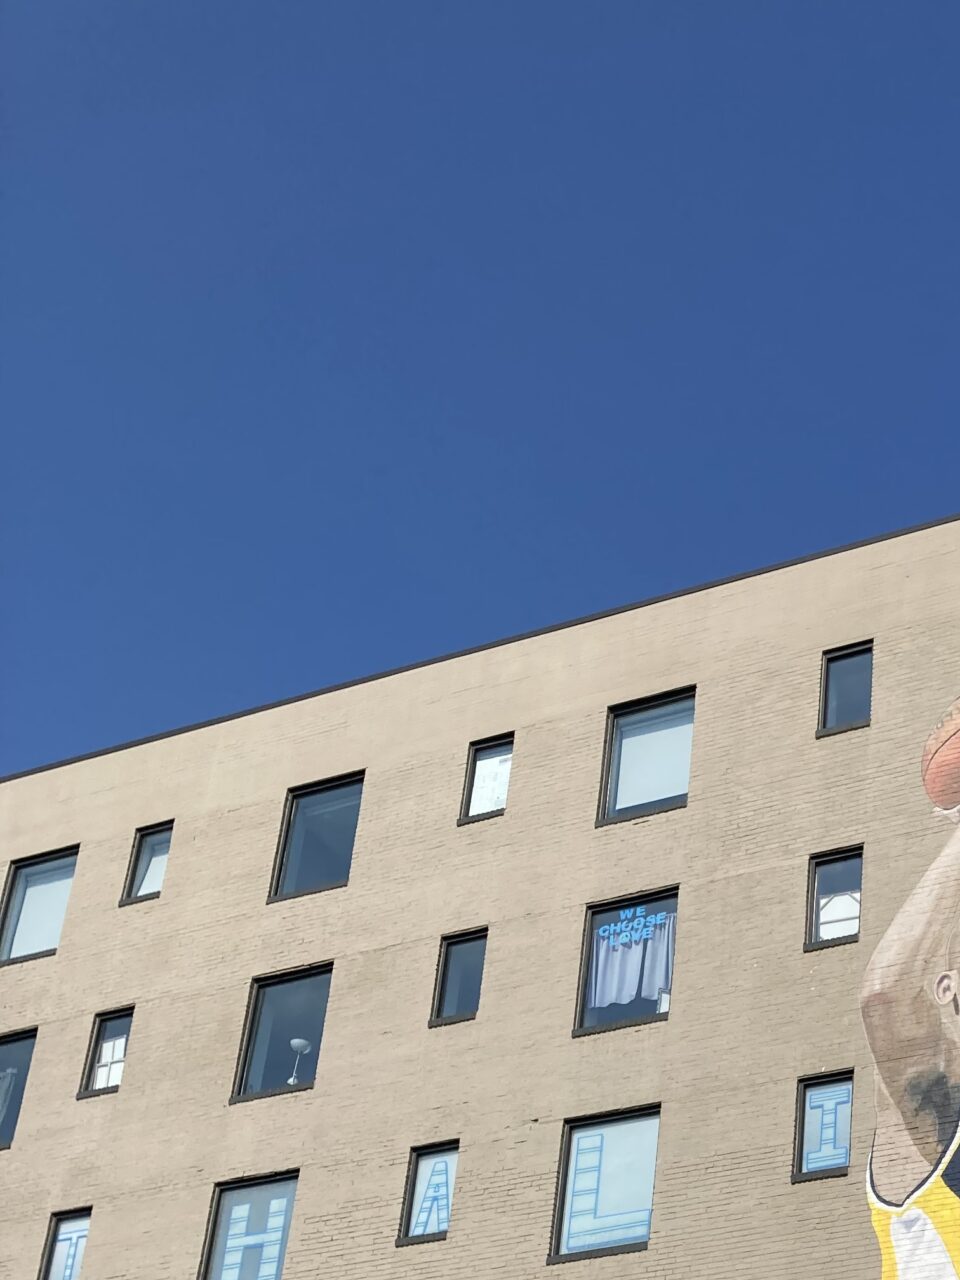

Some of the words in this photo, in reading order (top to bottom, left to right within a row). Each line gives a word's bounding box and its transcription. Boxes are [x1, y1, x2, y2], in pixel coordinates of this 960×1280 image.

[620, 906, 646, 920] WE
[599, 911, 667, 937] CHOOSE
[610, 927, 654, 946] LOVE
